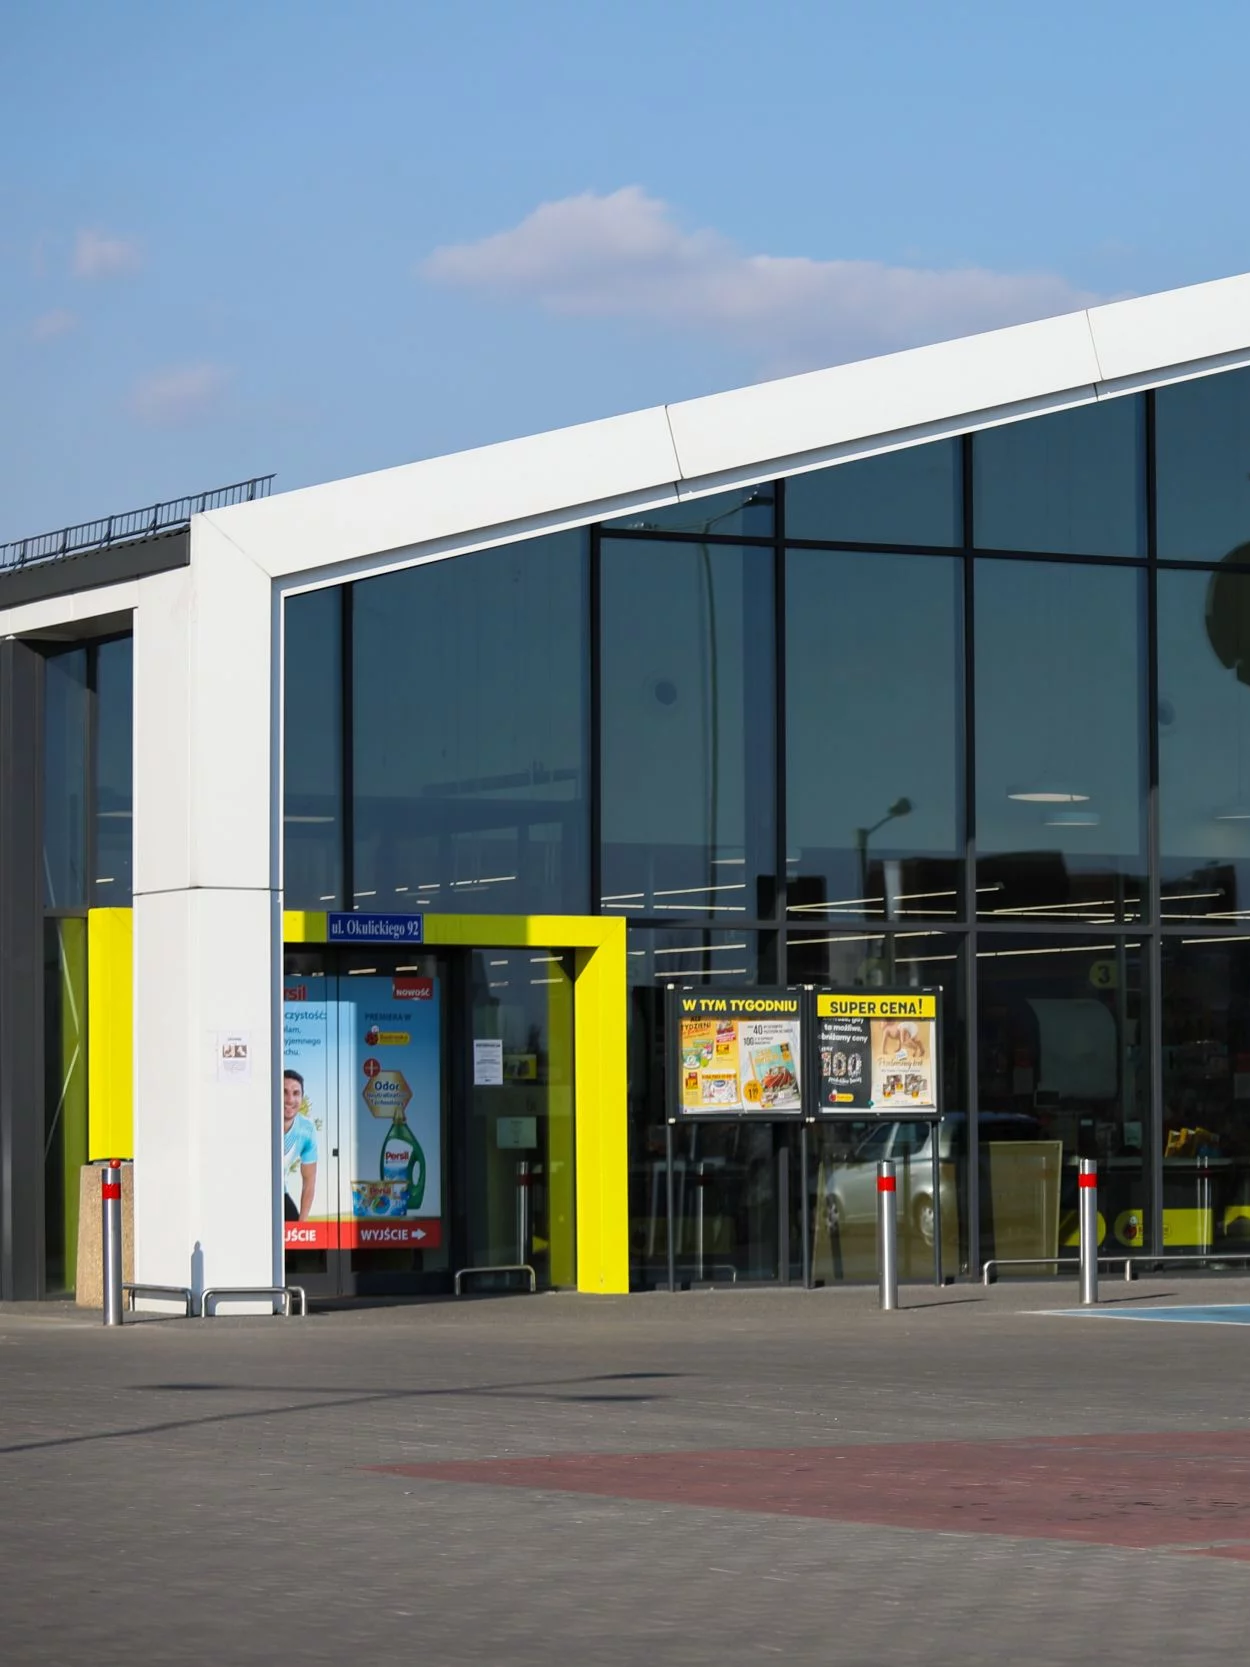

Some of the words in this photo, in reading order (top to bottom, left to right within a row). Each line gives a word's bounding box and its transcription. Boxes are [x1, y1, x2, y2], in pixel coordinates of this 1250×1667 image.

[331, 920, 344, 934] ul.
[346, 920, 405, 939] Okulickiego
[407, 920, 419, 936] 92
[1098, 965, 1110, 984] 3
[284, 984, 307, 1000] rsil
[396, 987, 431, 997] NOWOŚĆ
[683, 999, 697, 1011] W
[700, 999, 727, 1011] TYM
[730, 999, 798, 1012] TYGODNIU
[830, 1001, 876, 1014] SUPER
[753, 1024, 763, 1035] 40
[821, 1052, 863, 1078] 100
[374, 1080, 401, 1091] Odor
[385, 1151, 409, 1161] Persil
[284, 1228, 317, 1242] JŚCIE
[360, 1228, 409, 1241] WYJŚCIE
